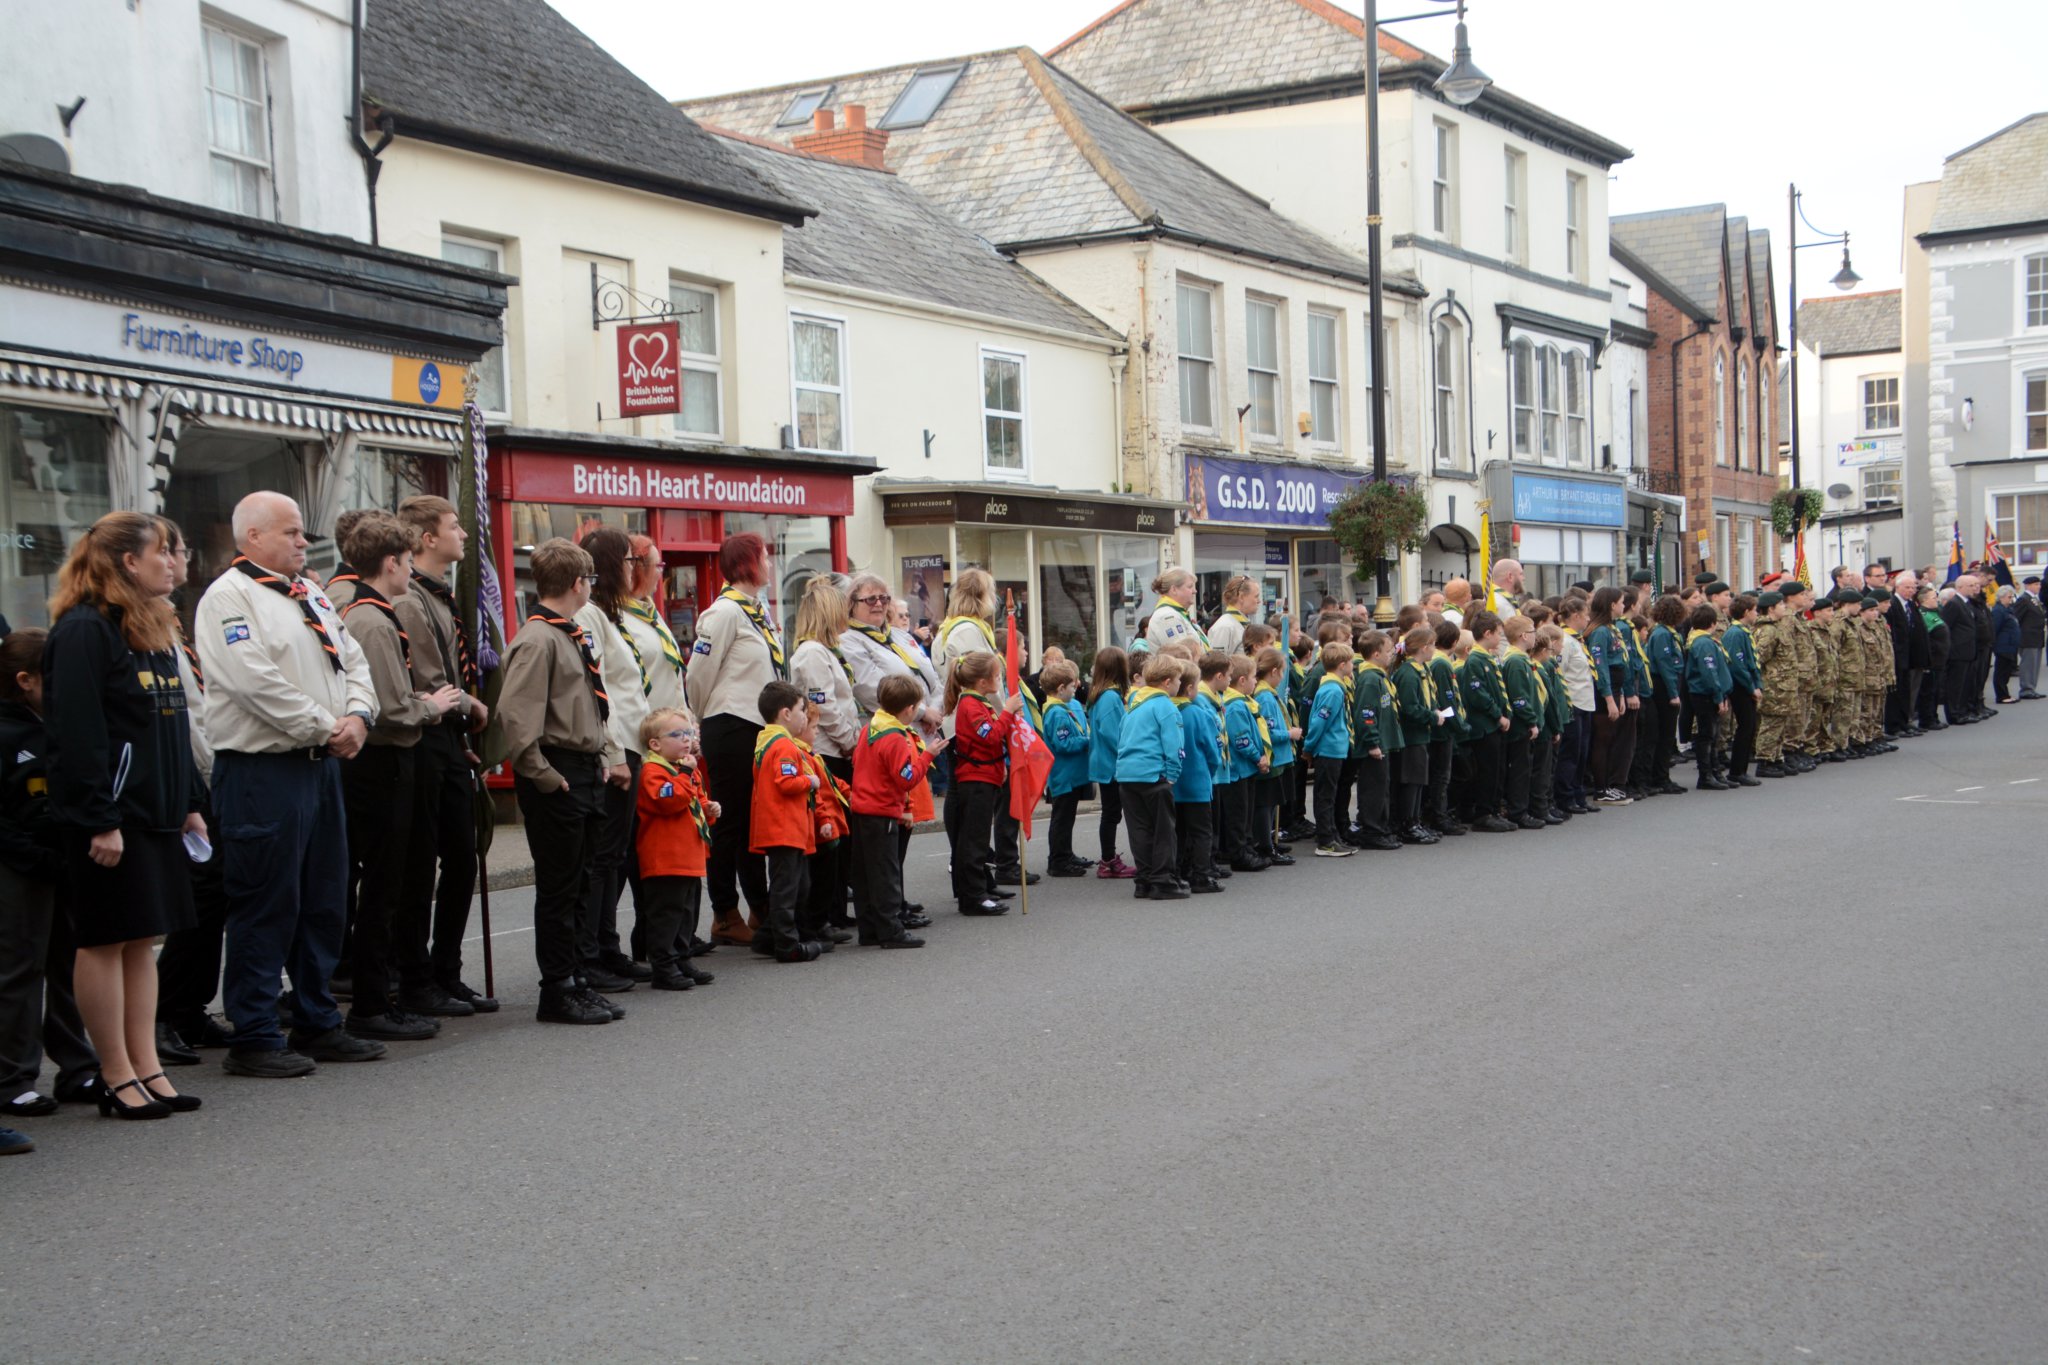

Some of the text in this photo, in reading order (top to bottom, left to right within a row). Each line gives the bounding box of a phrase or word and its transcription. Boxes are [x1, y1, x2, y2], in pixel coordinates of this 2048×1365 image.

[122, 313, 303, 381] Furniture Shop
[625, 384, 674, 396] British Heart
[626, 394, 675, 407] Foundation
[573, 464, 806, 505] British Heart Foundation
[1217, 474, 1270, 511] G.S.D.
[1276, 479, 1316, 514] 2000
[984, 496, 1008, 522] place
[1136, 508, 1155, 532] place
